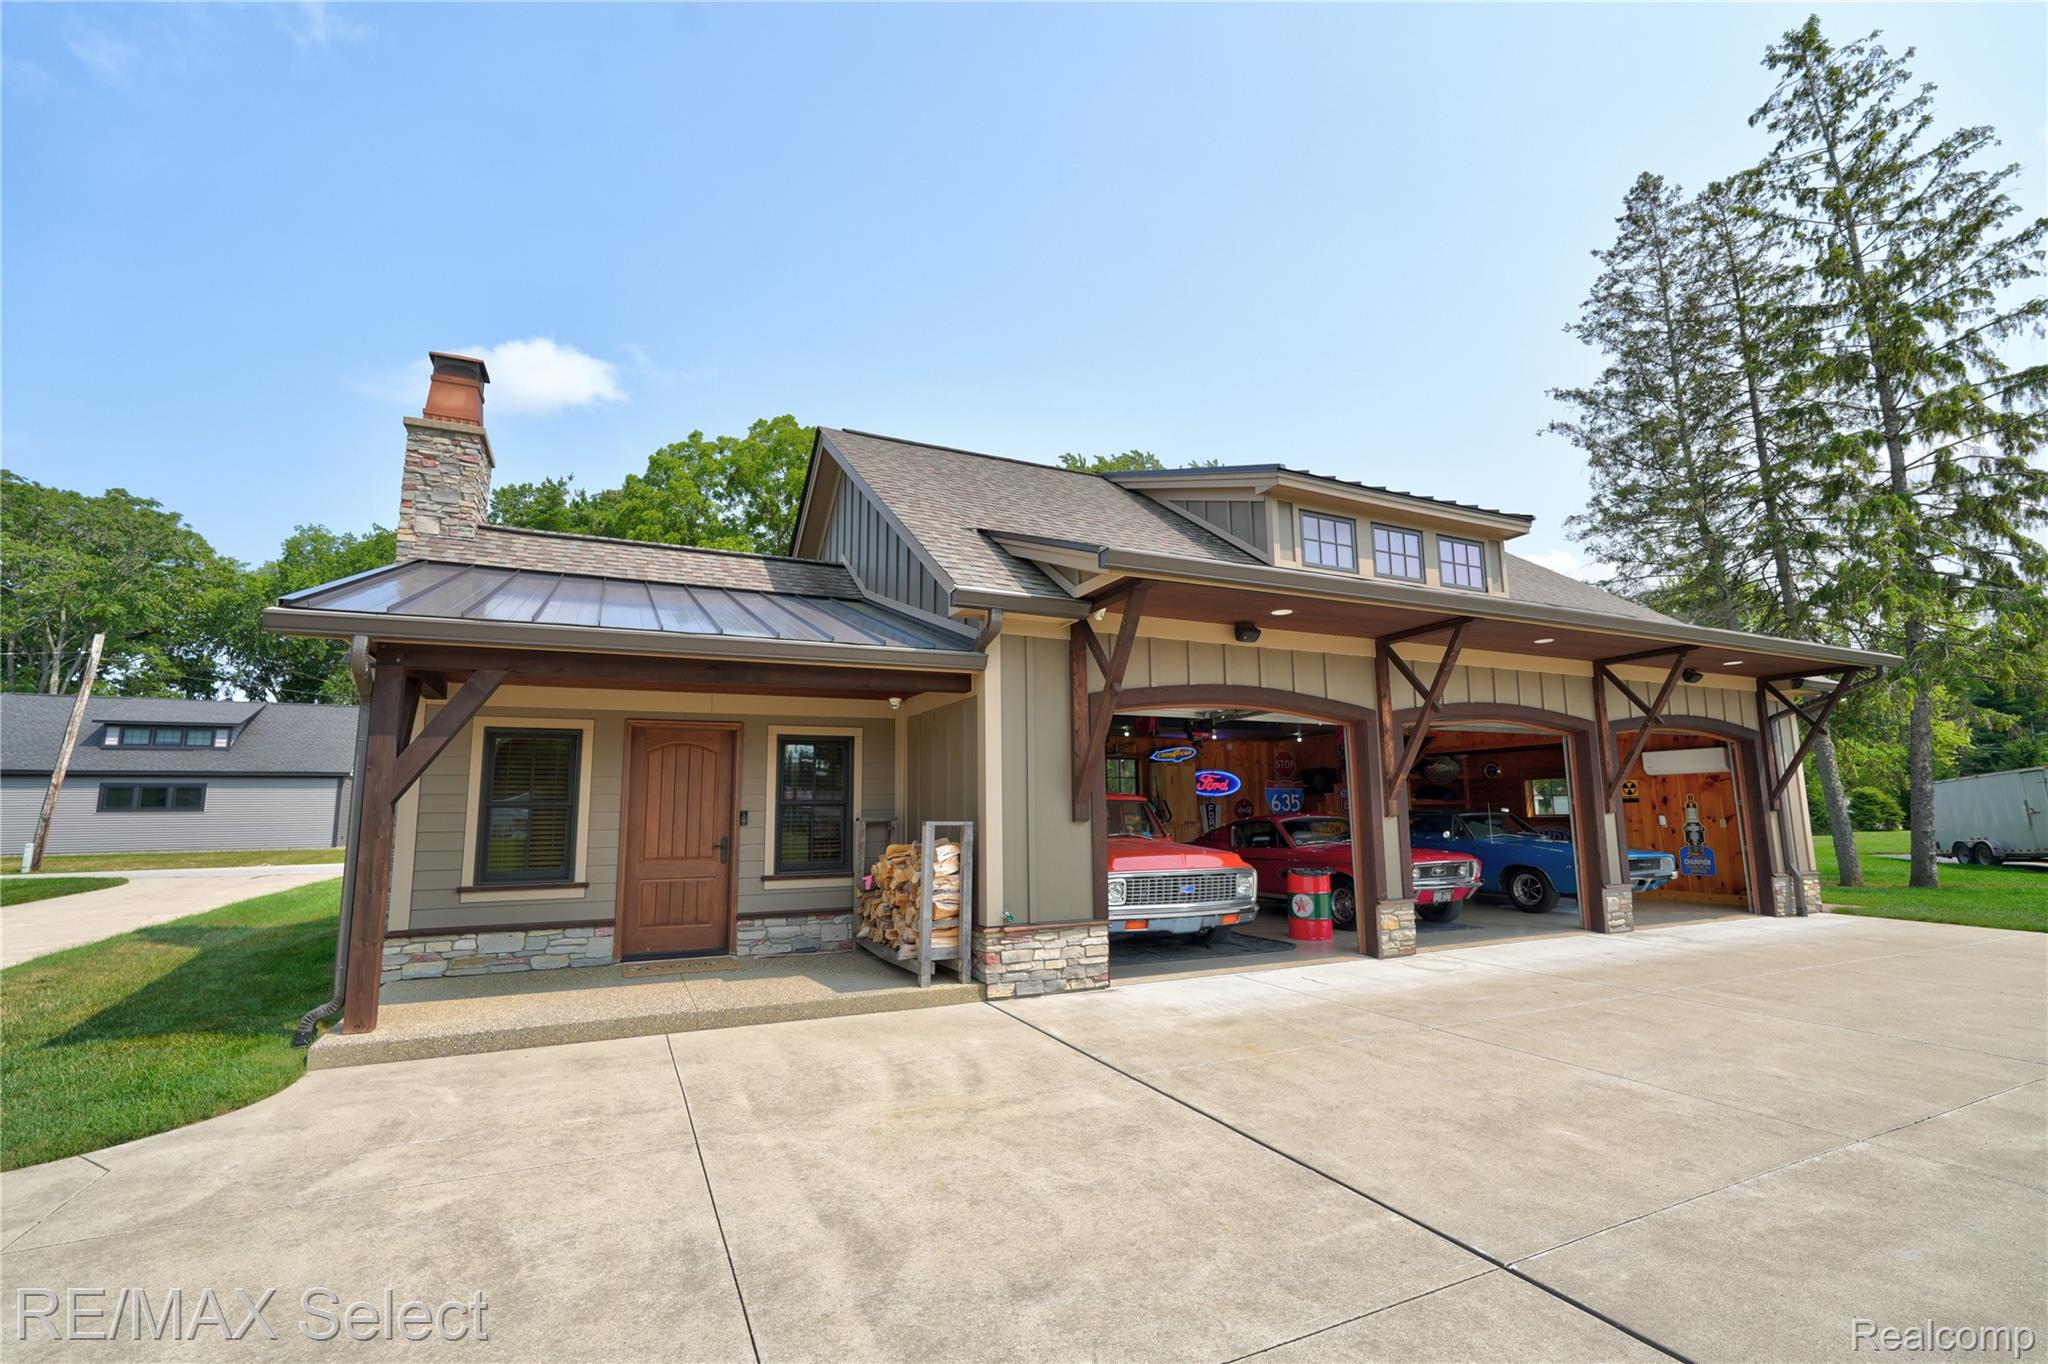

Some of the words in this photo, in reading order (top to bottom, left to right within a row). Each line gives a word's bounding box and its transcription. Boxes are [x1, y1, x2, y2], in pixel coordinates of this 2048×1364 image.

[1275, 759, 1296, 769] STOP
[1197, 774, 1229, 790] Ford
[1271, 793, 1301, 811] 635
